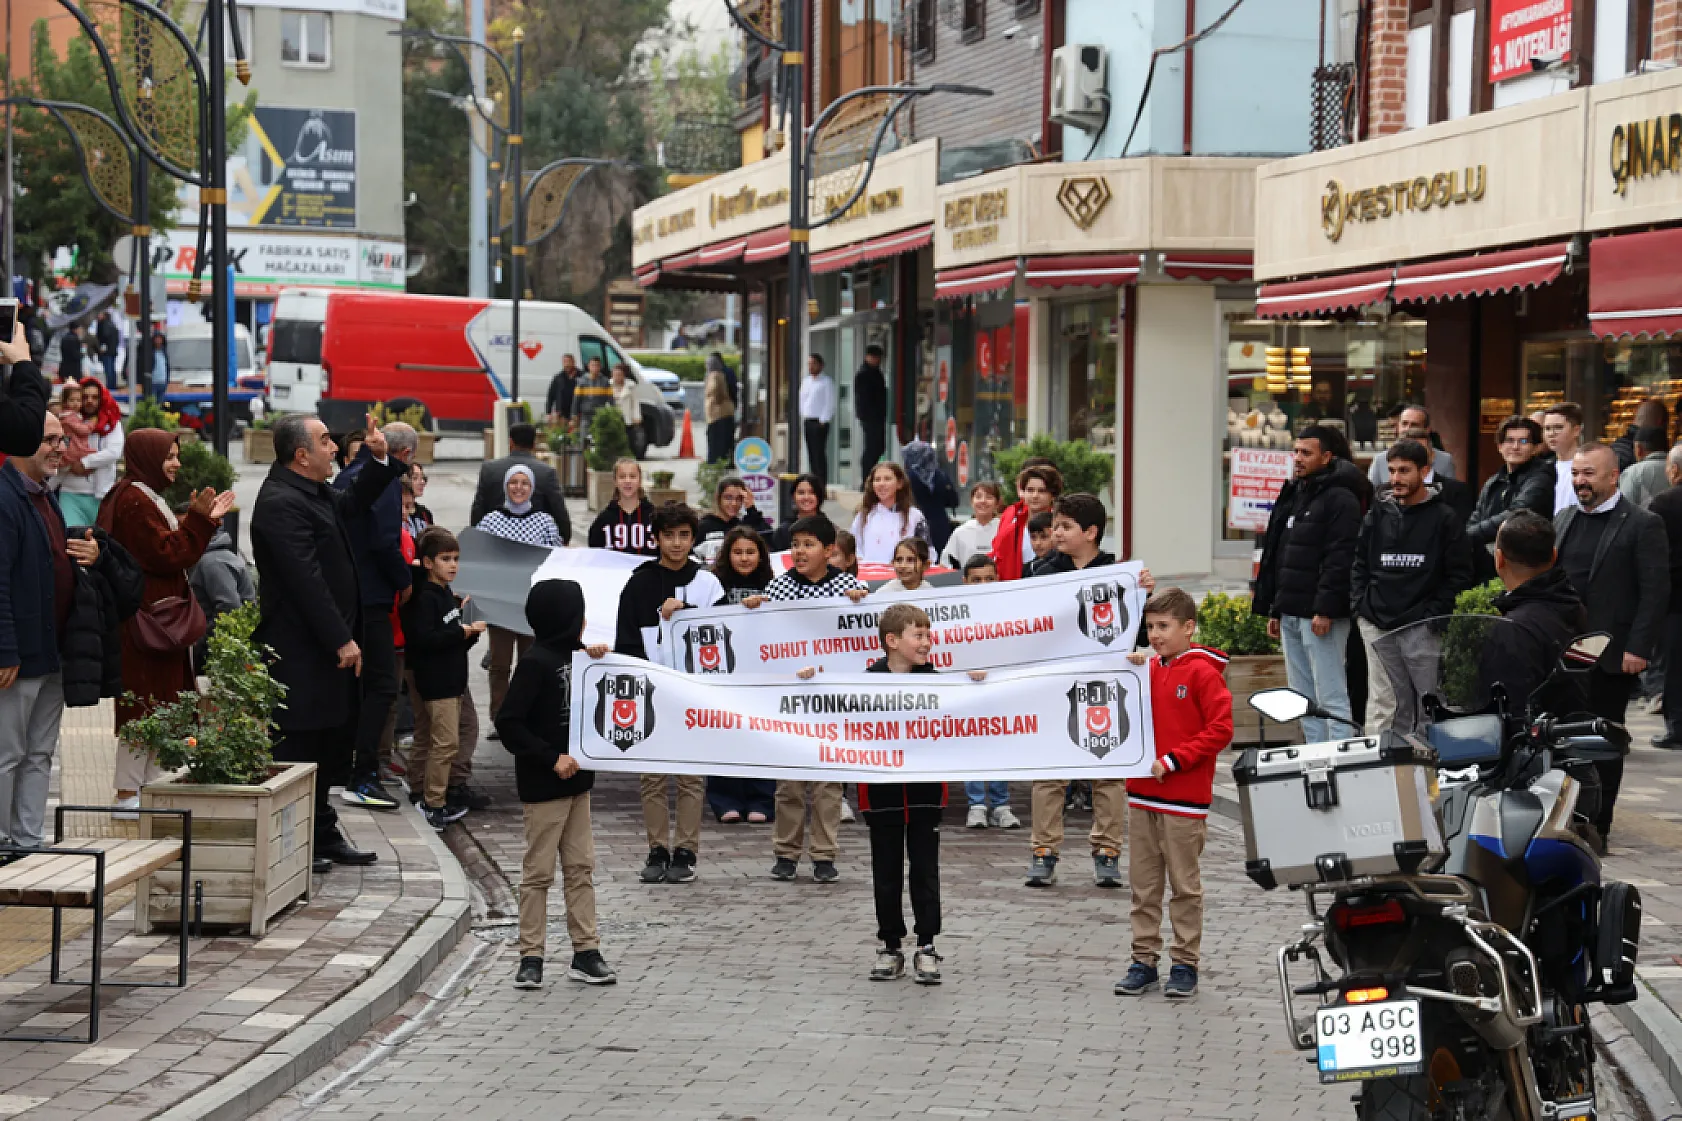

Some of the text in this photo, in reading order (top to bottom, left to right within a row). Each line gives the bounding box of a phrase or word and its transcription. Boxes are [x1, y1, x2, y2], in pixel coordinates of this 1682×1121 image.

[1492, 45, 1503, 75] 3.
[1610, 113, 1682, 197] ÇINAR
[1239, 451, 1287, 466] BEYZADE
[602, 523, 658, 550] 1903
[838, 602, 971, 630] AFYOHİSAR
[760, 640, 808, 663] ŞUHUT
[812, 635, 883, 656] KURTULU
[944, 615, 1055, 645] KÜÇÜKARSLAN
[605, 679, 646, 696] BJK
[1077, 685, 1118, 703] BJK
[779, 690, 940, 714] AFYONKARAHİSAR
[608, 729, 643, 741] 1903
[685, 708, 1038, 742] ŞUHUT KURTULUŞ İHSAN KÜÇÜKARSLAN
[818, 742, 904, 768] İLKOKULU
[1083, 736, 1119, 748] 1903
[1322, 1006, 1415, 1037] 03 AGC
[1370, 1034, 1416, 1060] 998
[1324, 1059, 1335, 1069] TR
